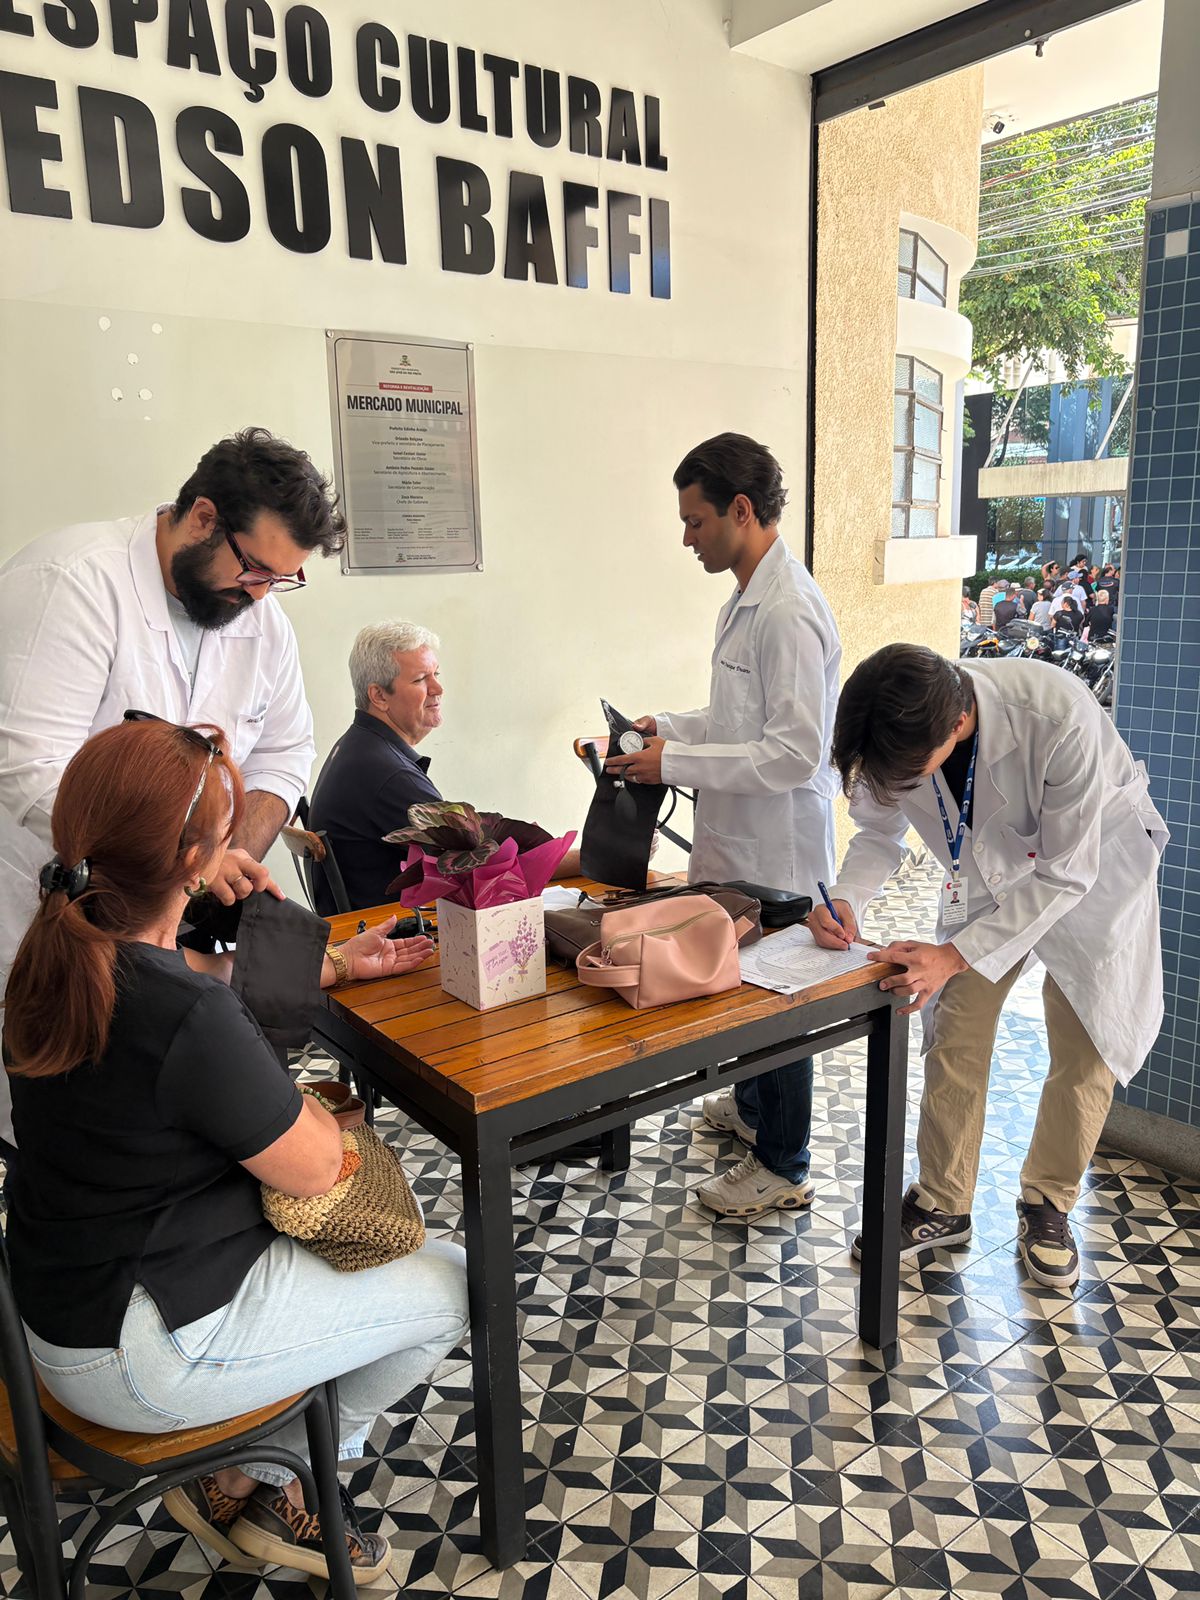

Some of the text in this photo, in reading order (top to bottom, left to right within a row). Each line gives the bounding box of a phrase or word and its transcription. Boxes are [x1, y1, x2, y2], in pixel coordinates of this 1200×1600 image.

[356, 22, 669, 171] CULTURAL
[0, 70, 672, 300] EDSON BAFFI
[347, 395, 463, 415] MERCADO MUNICIPAL
